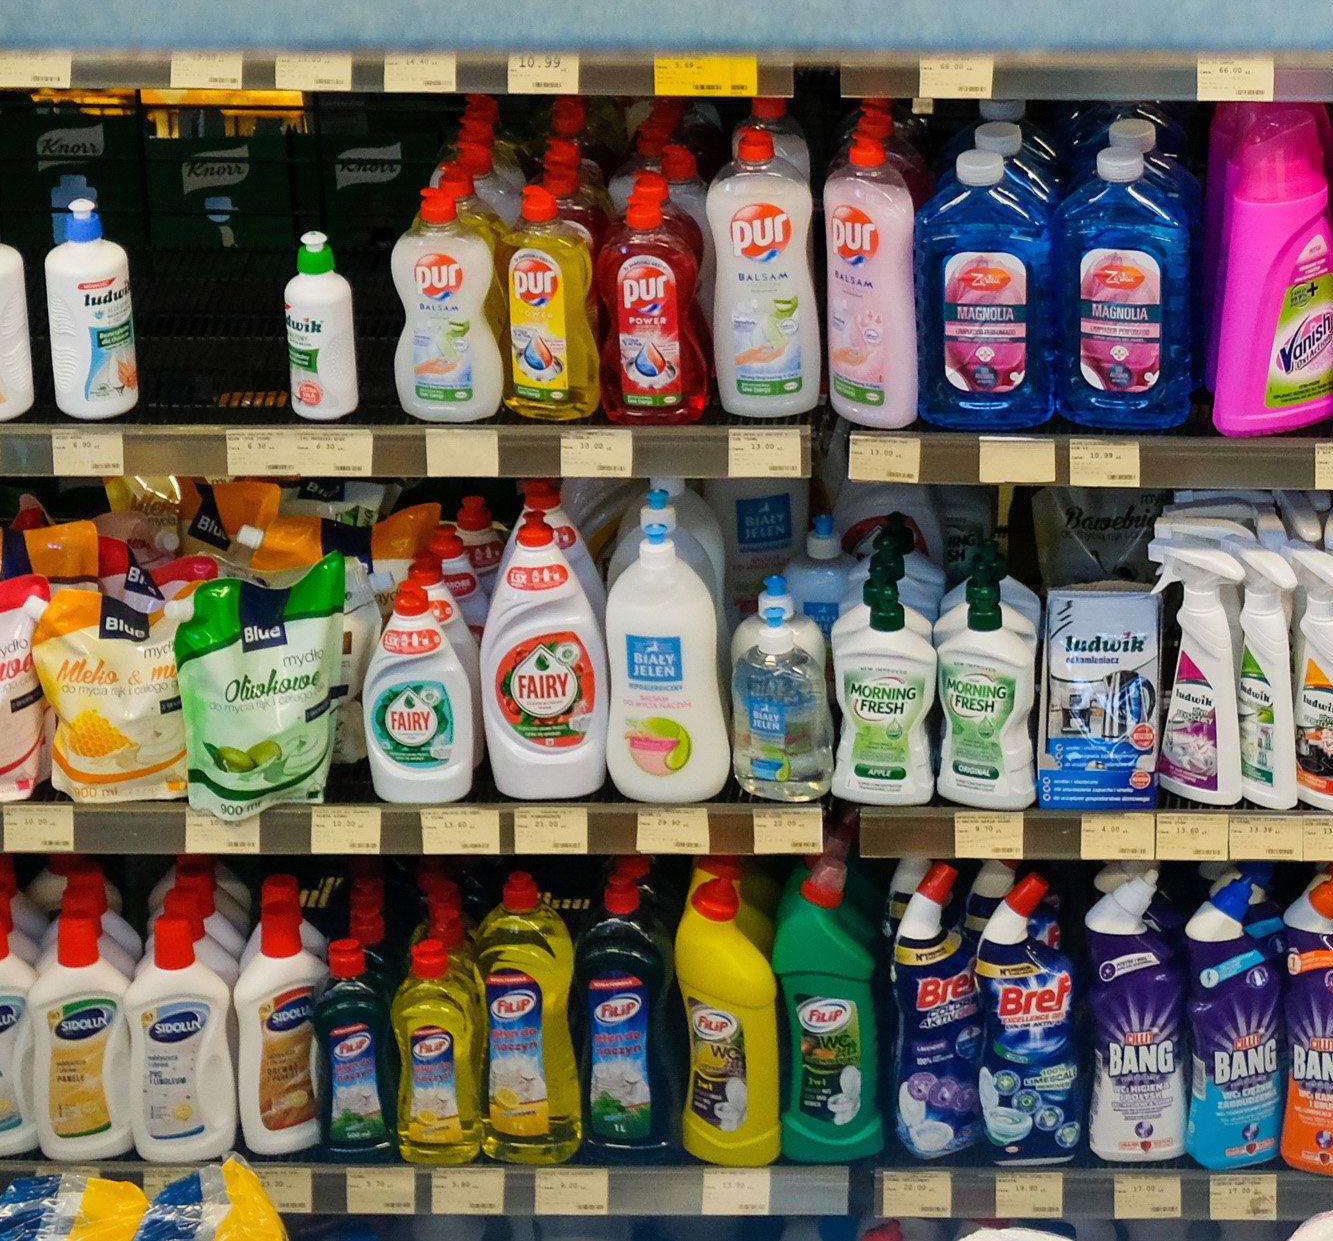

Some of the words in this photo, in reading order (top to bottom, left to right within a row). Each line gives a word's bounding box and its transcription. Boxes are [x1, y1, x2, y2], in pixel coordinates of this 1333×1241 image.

[732, 217, 787, 250] pur
[831, 222, 876, 250] pur
[416, 265, 460, 294] pur
[513, 270, 555, 296] pur
[739, 272, 788, 282] BALSAM
[834, 271, 873, 289] BALSAM
[624, 279, 674, 309] pur
[419, 303, 459, 312] BALSAM
[957, 305, 1014, 322] MAGNOLIA
[1092, 304, 1148, 322] MAGNOLIA
[629, 316, 667, 326] POWER
[106, 617, 144, 637] Blue
[244, 625, 280, 642] Blue
[1065, 632, 1145, 653] ludwik
[634, 653, 675, 666] BIAŁY
[1066, 655, 1119, 665] odkamieniacz
[633, 663, 675, 677] JELEŃ
[225, 669, 319, 702] Oliwkowe
[518, 674, 568, 698] FAIRY
[850, 683, 916, 702] MORNING
[947, 679, 1007, 700] MORNING
[859, 699, 904, 715] FRESH
[955, 696, 995, 712] FRESH
[1175, 689, 1214, 708] ludwik
[391, 712, 431, 732] FAIRY
[752, 712, 779, 722] BIAŁY
[752, 719, 780, 730] JELEŃ
[868, 768, 892, 777] APPLE
[999, 976, 1071, 1016] Bref
[60, 1014, 109, 1034] SIDOLUX
[154, 1014, 202, 1036] SIDOLUX
[1126, 1033, 1153, 1046] CILLIT
[1235, 1035, 1259, 1049] CILLIT
[1110, 1045, 1173, 1076] BANG
[1214, 1047, 1277, 1083] BANG
